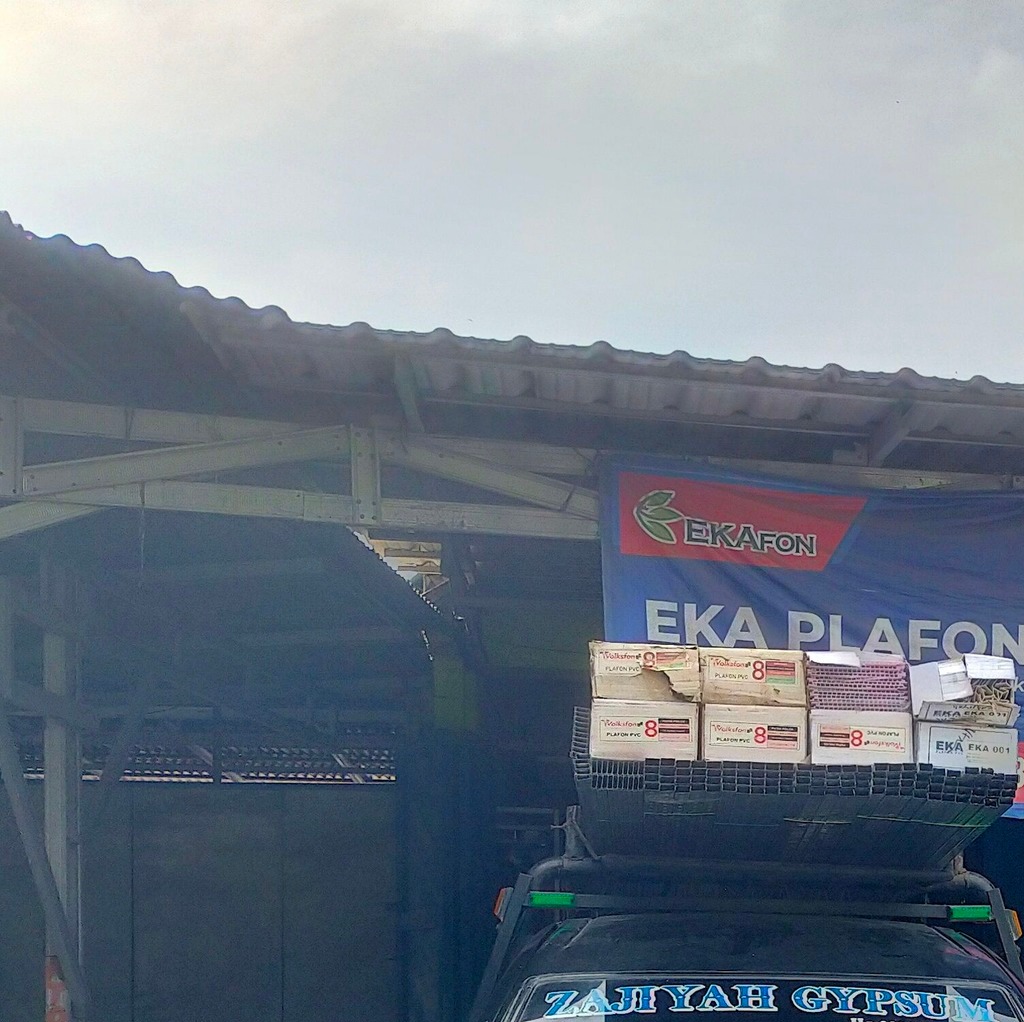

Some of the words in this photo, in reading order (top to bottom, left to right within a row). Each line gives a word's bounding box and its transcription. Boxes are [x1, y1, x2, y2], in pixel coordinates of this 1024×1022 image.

[684, 517, 817, 556] EKAFON
[645, 599, 768, 649] EKA
[752, 660, 765, 680] 8
[644, 720, 658, 738] 8
[754, 726, 766, 744] 8
[851, 730, 863, 747] 8
[935, 740, 964, 752] EKA
[968, 743, 989, 752] EKA
[992, 746, 1010, 754] 001
[543, 984, 778, 1019] ZAJIYAH
